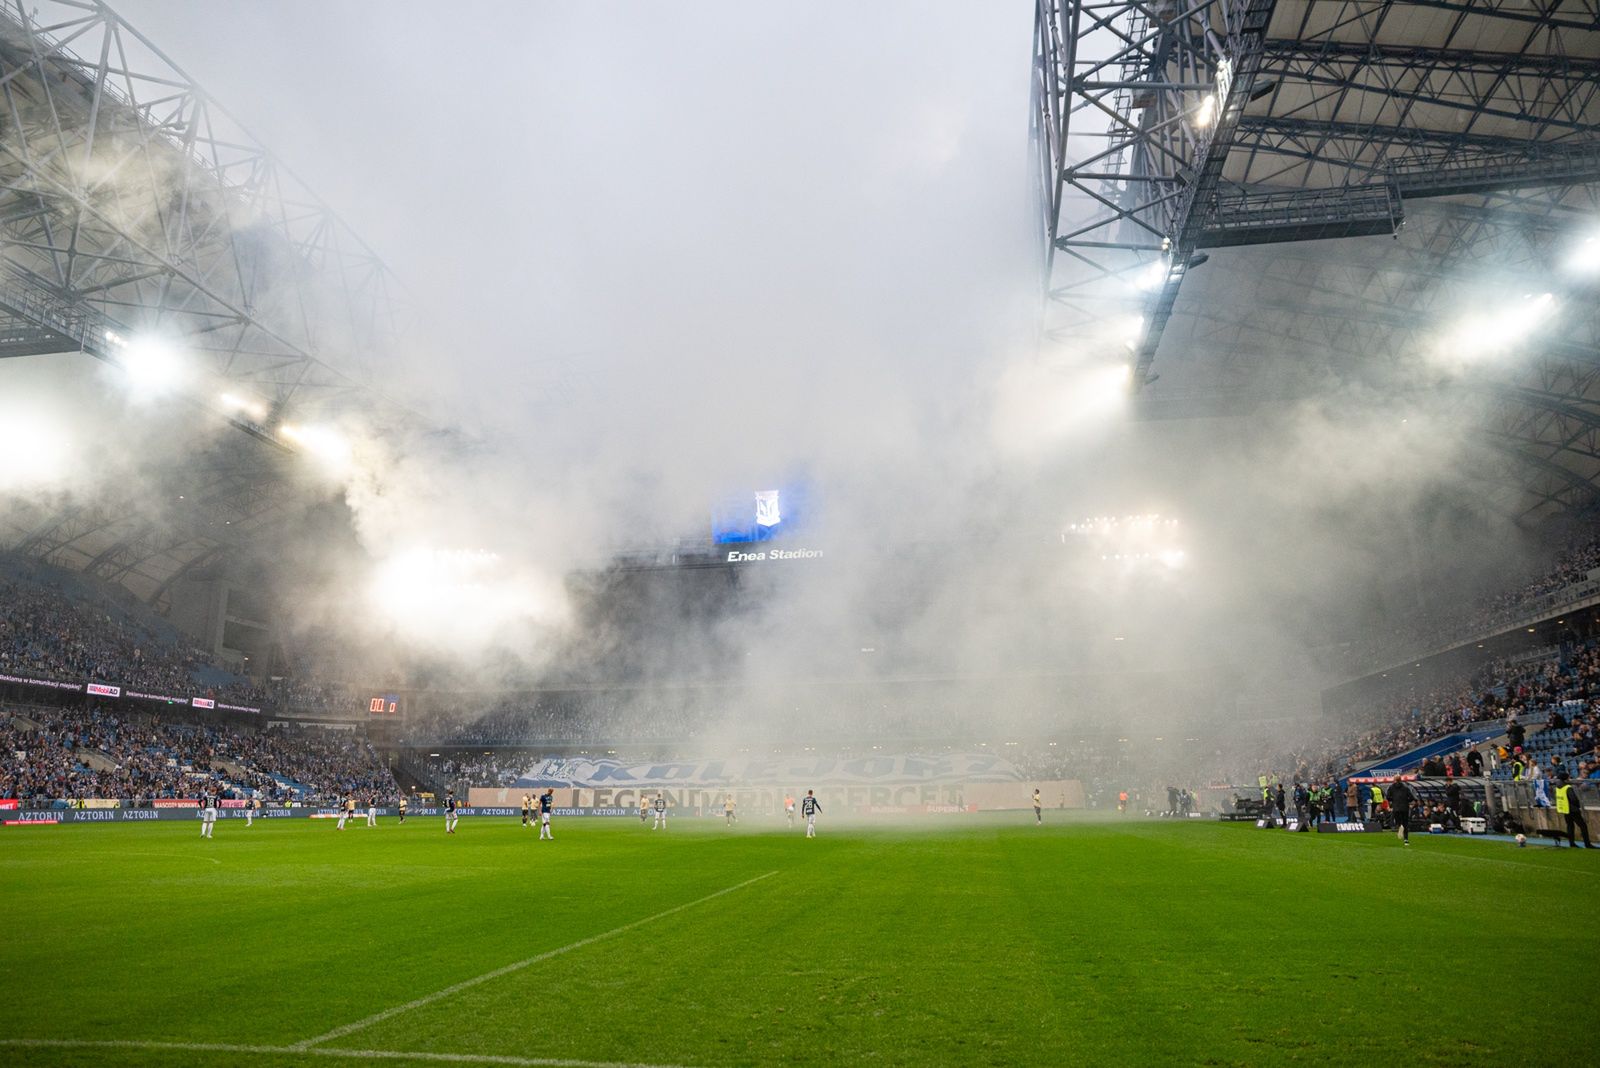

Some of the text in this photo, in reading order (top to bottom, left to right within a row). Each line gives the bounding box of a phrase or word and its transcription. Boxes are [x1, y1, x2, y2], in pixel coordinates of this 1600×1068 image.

[728, 548, 824, 562] Enea Stadion
[0, 674, 22, 683] Reklama
[29, 677, 59, 689] komunikacji
[18, 811, 65, 821] AZTORIN
[73, 810, 114, 820] AZTORIN
[122, 810, 159, 819] AZTORIN
[196, 810, 227, 818] AZRIN
[443, 808, 476, 816] AORIN
[481, 808, 514, 816] AZTORIN
[551, 808, 585, 816] AZTORIN
[591, 808, 626, 816] AZTORIN
